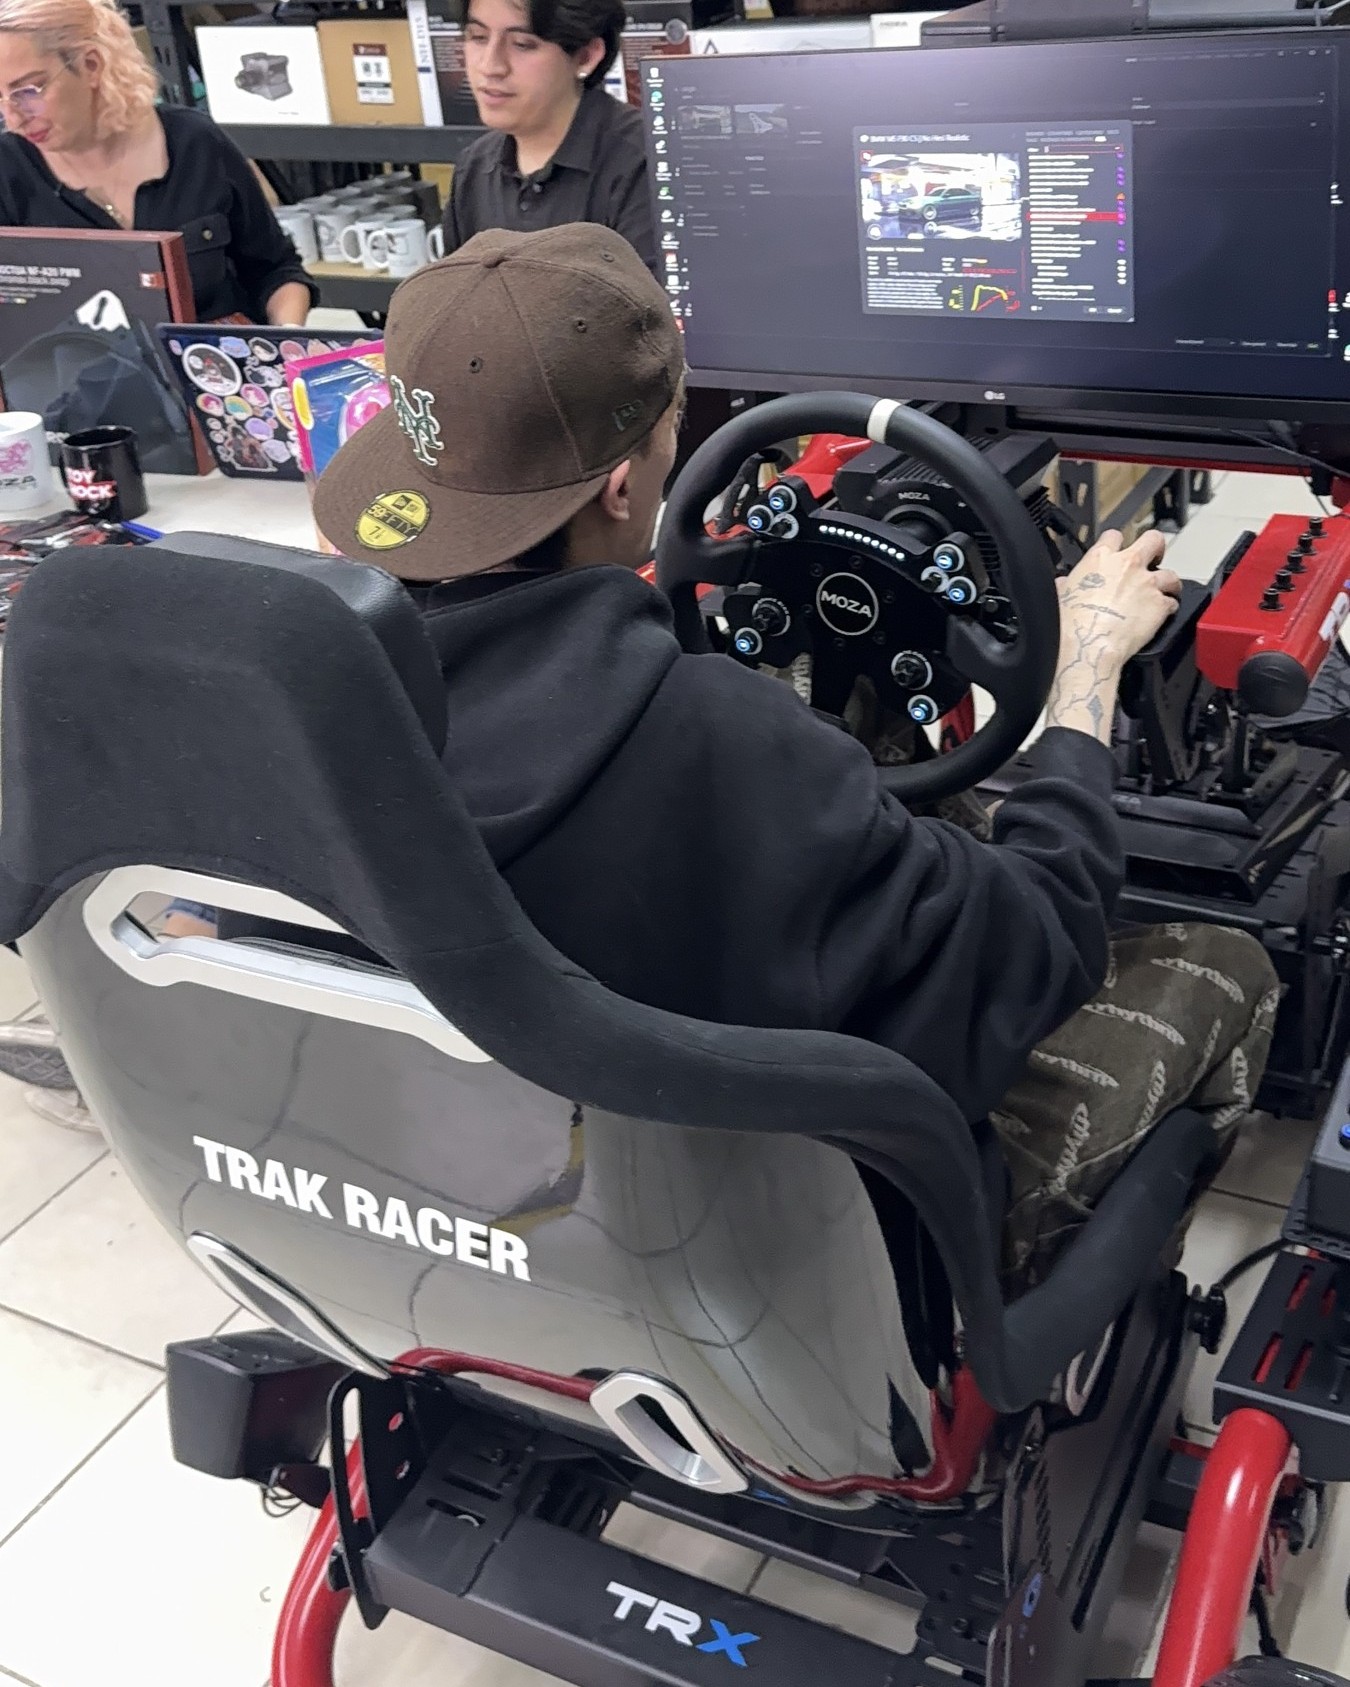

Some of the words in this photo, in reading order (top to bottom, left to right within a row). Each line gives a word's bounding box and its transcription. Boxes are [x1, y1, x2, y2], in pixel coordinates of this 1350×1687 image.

[898, 491, 931, 501] MOZA
[821, 590, 872, 618] MOZA
[193, 1135, 333, 1219] TRAK
[342, 1182, 531, 1282] RACER
[605, 1580, 761, 1668] TRX
